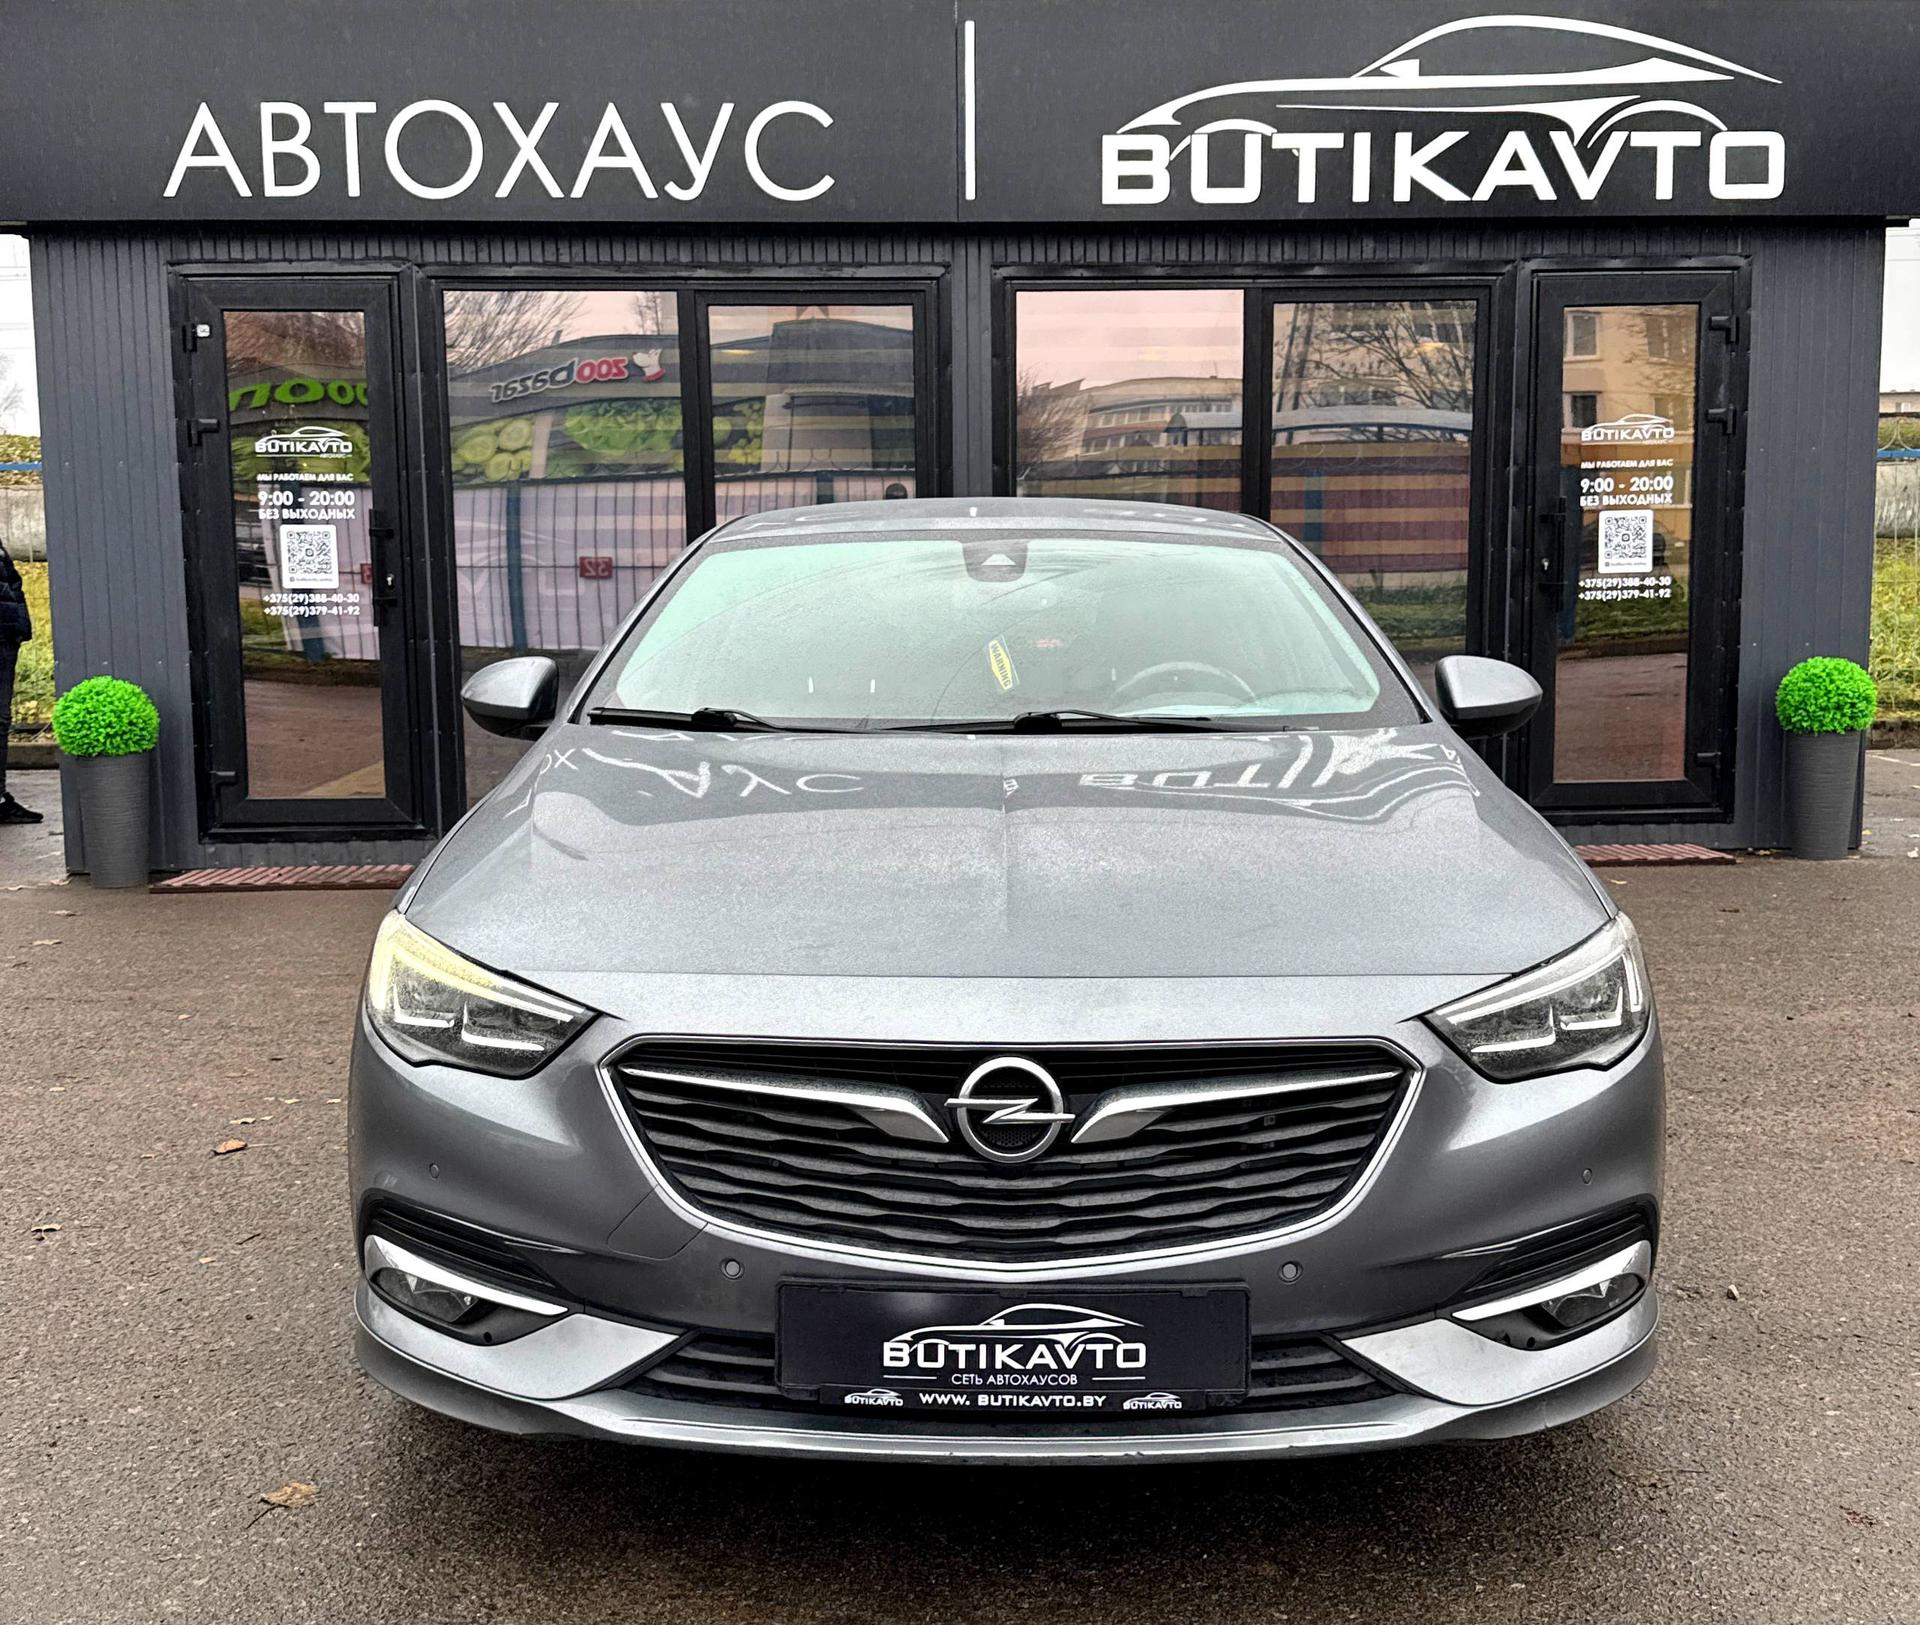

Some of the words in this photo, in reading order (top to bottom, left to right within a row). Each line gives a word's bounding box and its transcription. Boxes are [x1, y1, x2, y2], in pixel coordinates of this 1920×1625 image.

[163, 99, 835, 202] АВТОХАУС
[1102, 130, 1785, 205] BUTIKAVTO
[1581, 427, 1675, 441] BUTIKAVTO
[255, 441, 353, 453] BUTIKAVTO
[1580, 461, 1595, 469] МЫ
[1596, 460, 1638, 469] РАБОТАЕМ
[1638, 460, 1655, 468] ДЛЯ
[1656, 458, 1674, 467] ВАС
[257, 473, 272, 481] МЫ
[273, 473, 317, 481] РАБОТАЕМ
[317, 473, 335, 481] ДЛЯ
[336, 473, 354, 481] ВАС
[1580, 477, 1615, 493] 9:00
[1629, 475, 1674, 492] 20:00
[258, 490, 294, 506] 9:00
[309, 490, 355, 506] 20:00
[1580, 495, 1600, 507] БЕЗ
[1602, 493, 1673, 506] ВЫХОДНЫХ
[258, 508, 280, 520] БЕЗ
[282, 508, 356, 520] ВЫХОДНЫХ
[991, 642, 1011, 687] WARNING
[883, 1341, 1147, 1370] BUTIKAVTO
[951, 1373, 983, 1386] СЕТЬ
[986, 1374, 1078, 1387] АВТОХАУСОВ
[844, 1395, 904, 1407] BUTIKAVTO
[1123, 1400, 1183, 1410] BUTIKAVTO
